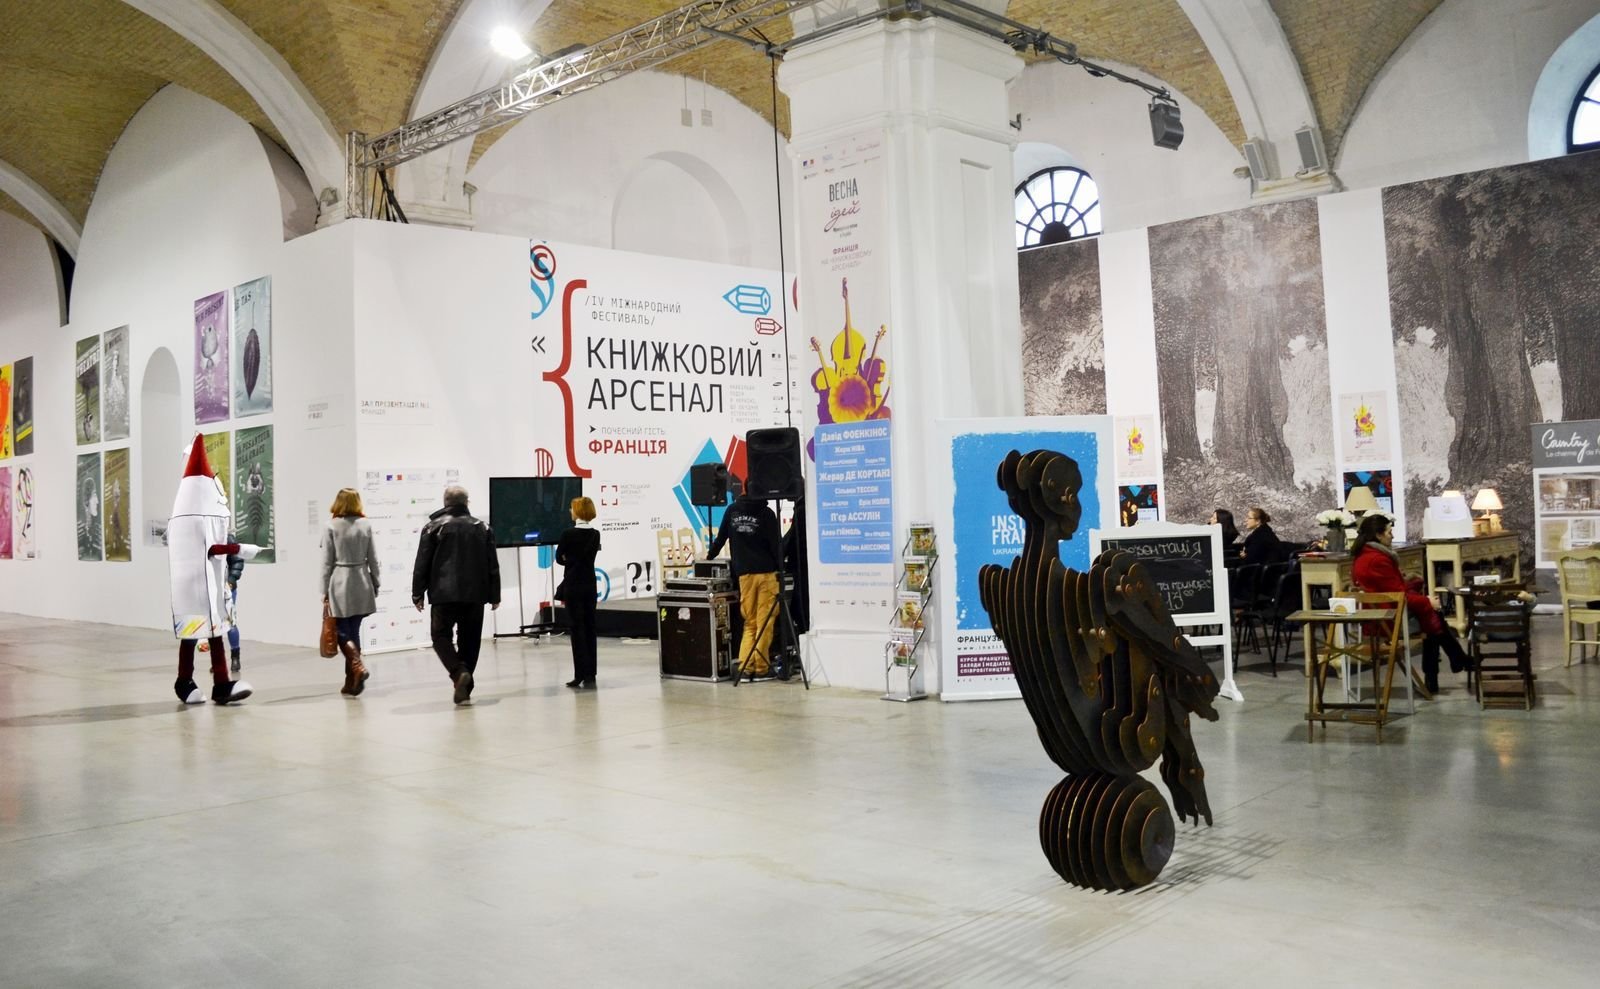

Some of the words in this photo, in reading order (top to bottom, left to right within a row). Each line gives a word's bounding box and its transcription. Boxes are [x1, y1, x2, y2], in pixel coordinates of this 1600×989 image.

[829, 178, 858, 202] ВЕСНА
[833, 244, 859, 255] ФРАНЦІЯ
[611, 298, 681, 314] МІЖНАРОДНИЙ
[586, 336, 762, 378] КНИЖКОВИЙ
[587, 378, 723, 413] АРСЕНАЛ
[601, 426, 643, 435] ПОЧЕСНИЙ
[644, 427, 666, 435] ГІСТЬ
[821, 432, 842, 443] Давід
[588, 439, 667, 457] ФРАНЦІЯ
[1541, 428, 1590, 464] Country
[819, 472, 845, 483] Жерар
[845, 471, 856, 481] ДЕ
[848, 511, 880, 521] АССУЛІН
